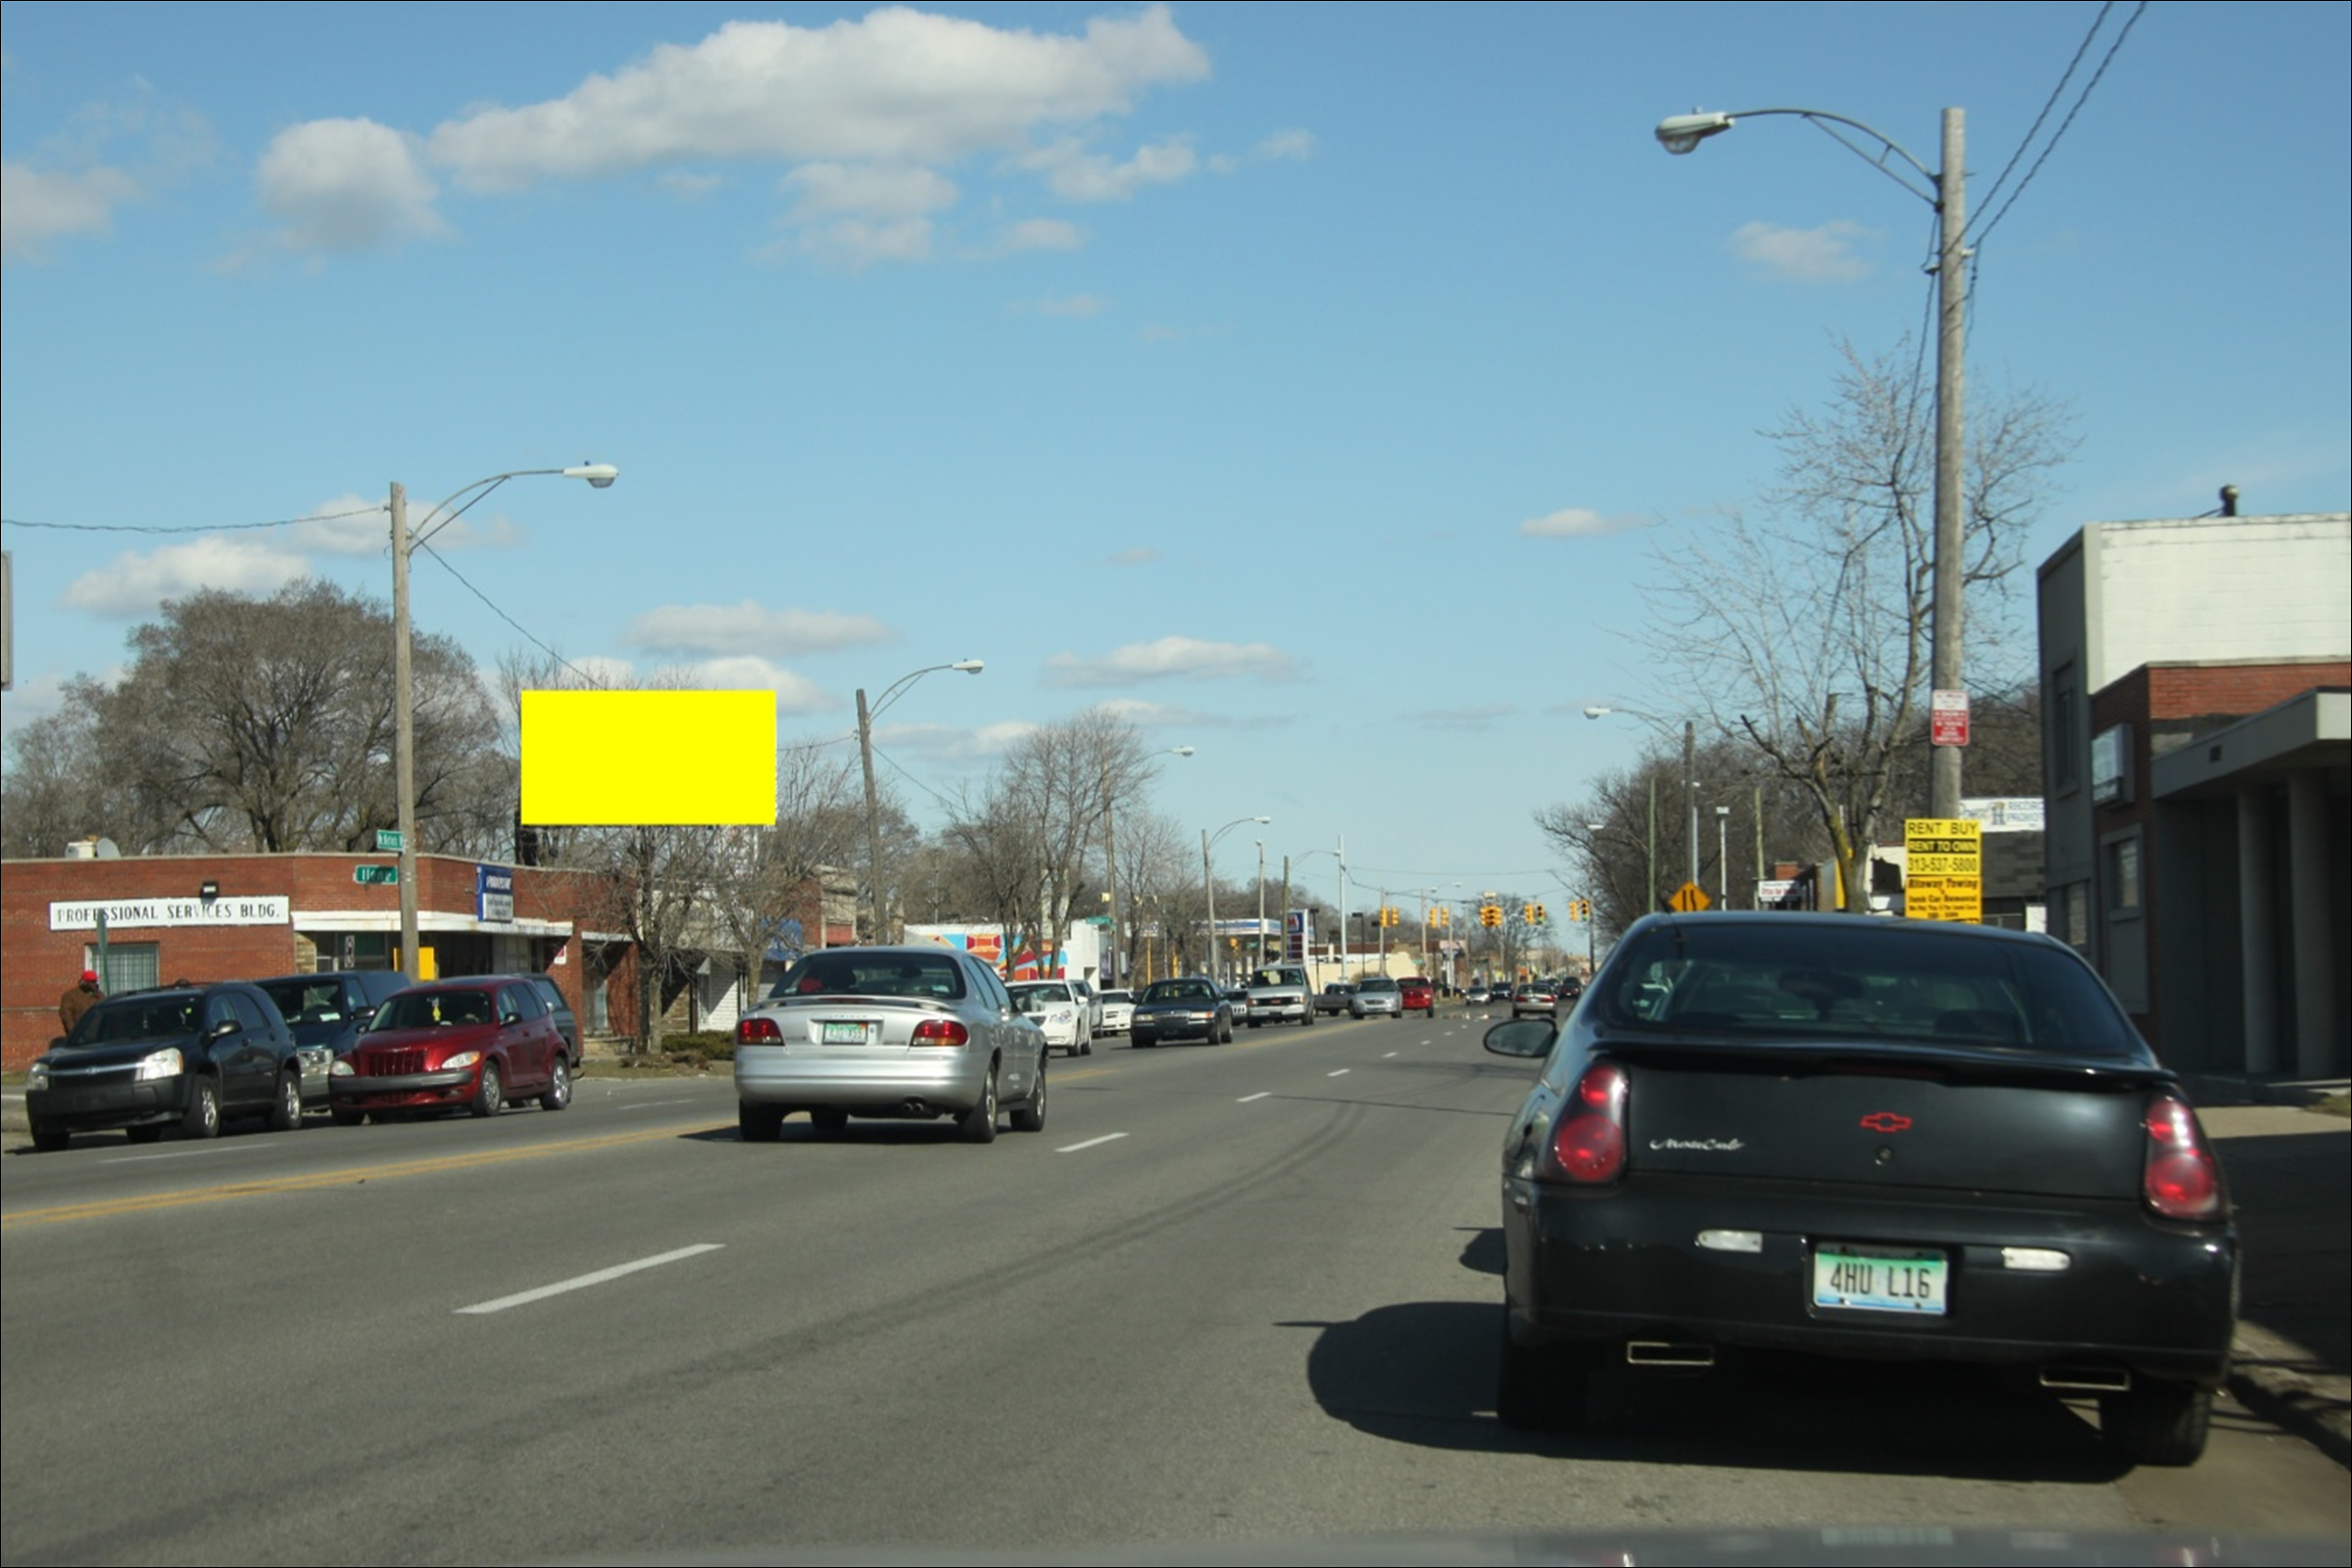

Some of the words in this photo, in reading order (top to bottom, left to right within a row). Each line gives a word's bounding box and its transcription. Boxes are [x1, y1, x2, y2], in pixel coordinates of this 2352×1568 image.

[1908, 822, 1941, 834] RENT
[1950, 822, 1978, 835] BUY
[1908, 841, 1936, 852] RENT
[1937, 841, 1950, 852] TO
[1952, 841, 1977, 852] OWN
[57, 906, 159, 922] PROFESSIONAL
[167, 903, 231, 919] SERVICES
[240, 903, 280, 918] BLDG.
[1830, 1262, 1873, 1295] 4HU
[1887, 1265, 1931, 1298] L16
